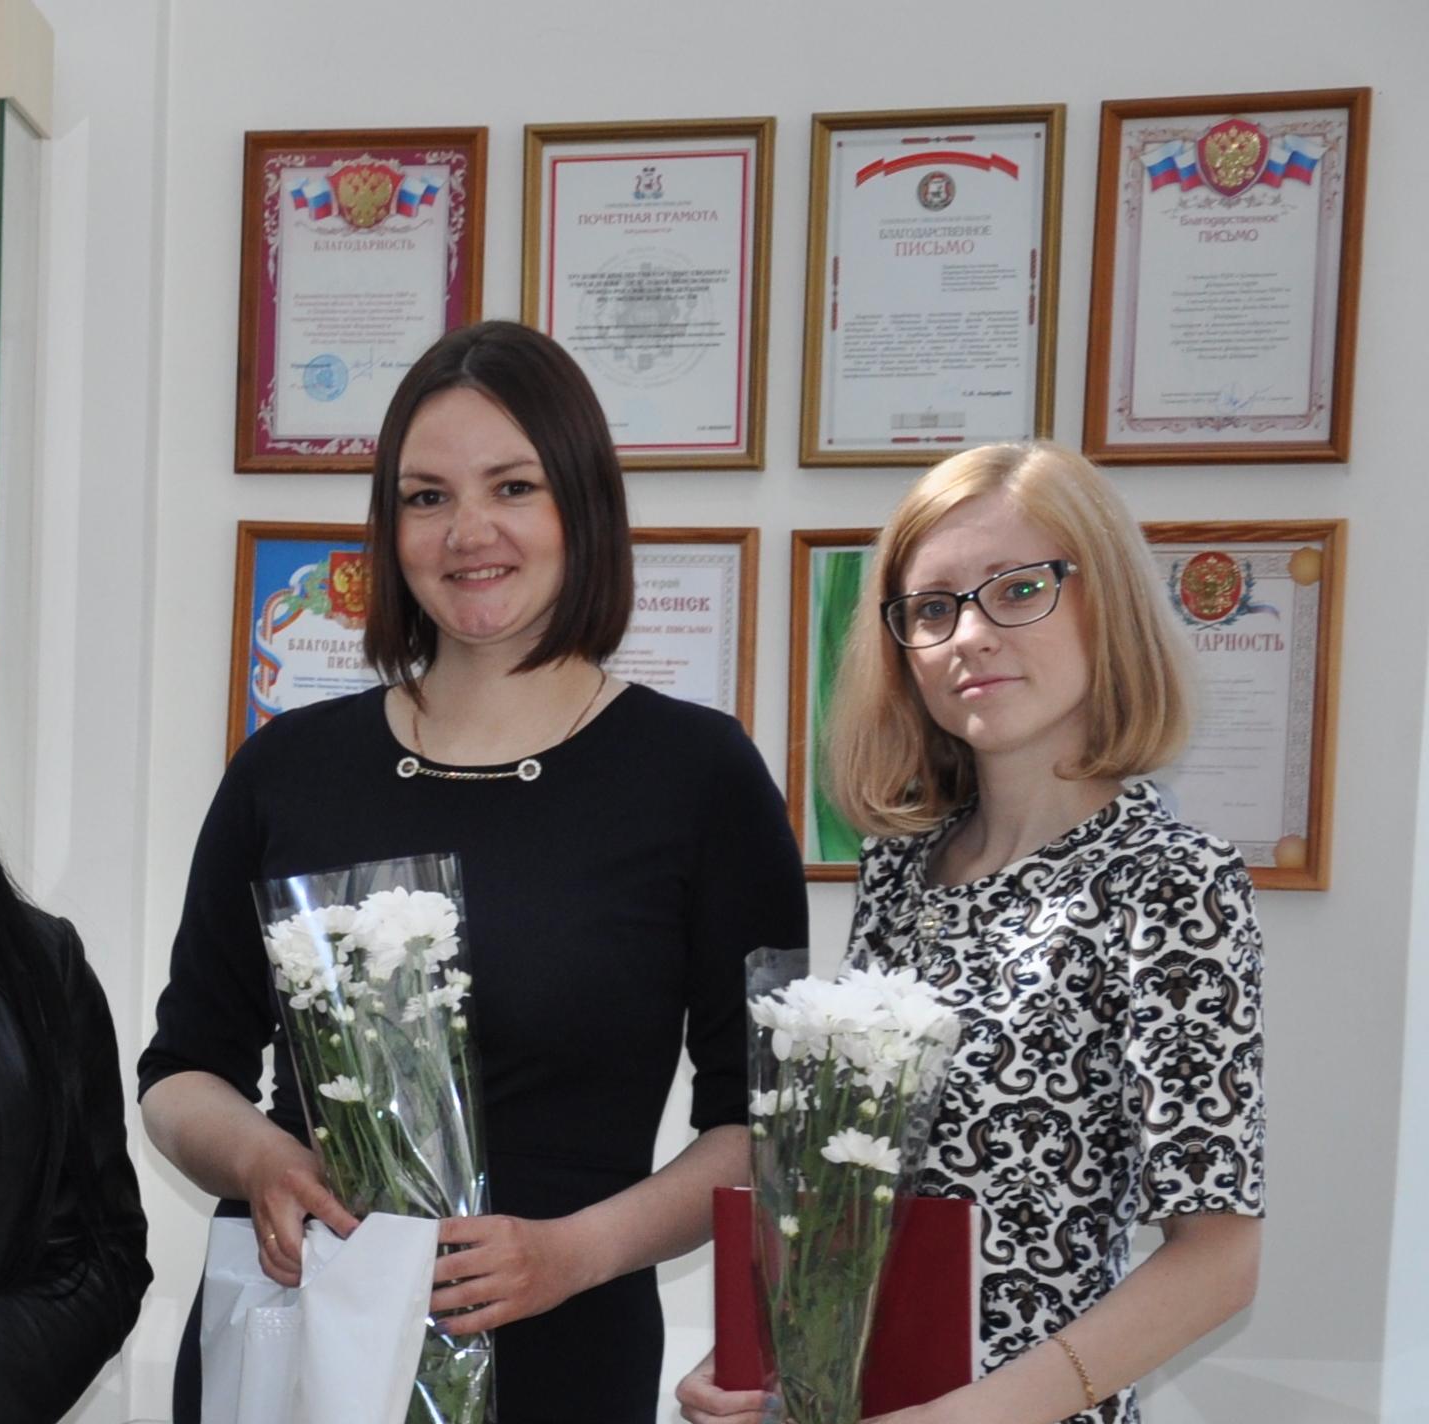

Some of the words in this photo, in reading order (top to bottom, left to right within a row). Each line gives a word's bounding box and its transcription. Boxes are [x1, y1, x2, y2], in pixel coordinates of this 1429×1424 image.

[578, 212, 652, 225] ПОЧЕТНАЯ
[655, 210, 719, 223] ГРАМОТА
[879, 225, 993, 240] БЛАГОДАРСТВЕННОЕ
[1198, 229, 1259, 242] ПИСЬМО
[313, 239, 416, 252] БЛАГОДАРНОСТЬ
[894, 240, 975, 257] ПИСЬМО
[636, 596, 711, 612] ОЛЕНСК
[287, 638, 365, 654] БЛАГОДАРС
